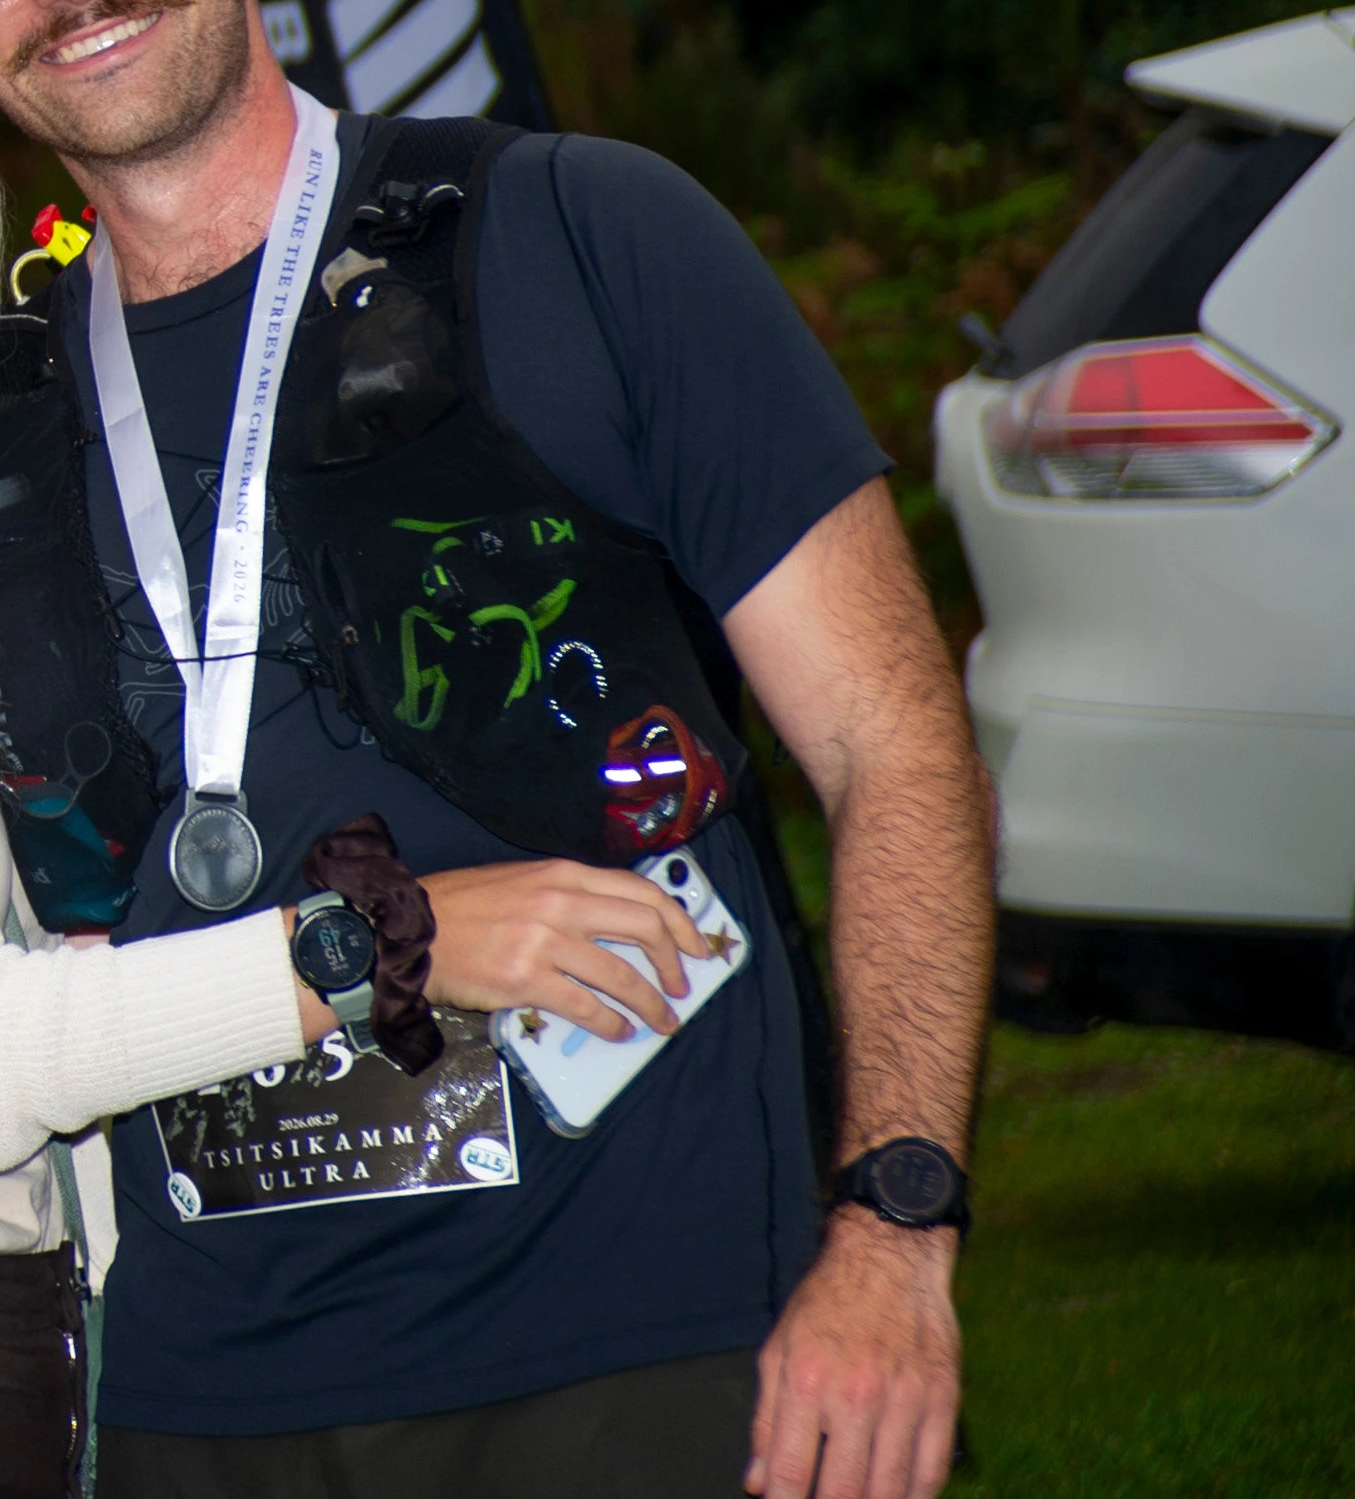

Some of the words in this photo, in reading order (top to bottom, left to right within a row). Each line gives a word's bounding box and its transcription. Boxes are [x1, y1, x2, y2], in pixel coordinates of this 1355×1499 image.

[305, 148, 323, 187] RUN
[290, 191, 316, 240] LIKE
[278, 245, 301, 287] THE
[263, 293, 289, 360] TREES
[253, 366, 272, 407] ARE
[235, 412, 263, 534] CHEERING
[233, 559, 248, 603] 2026
[202, 1122, 444, 1170] TSITSIKAMMA
[258, 1160, 371, 1192] ULTRA
